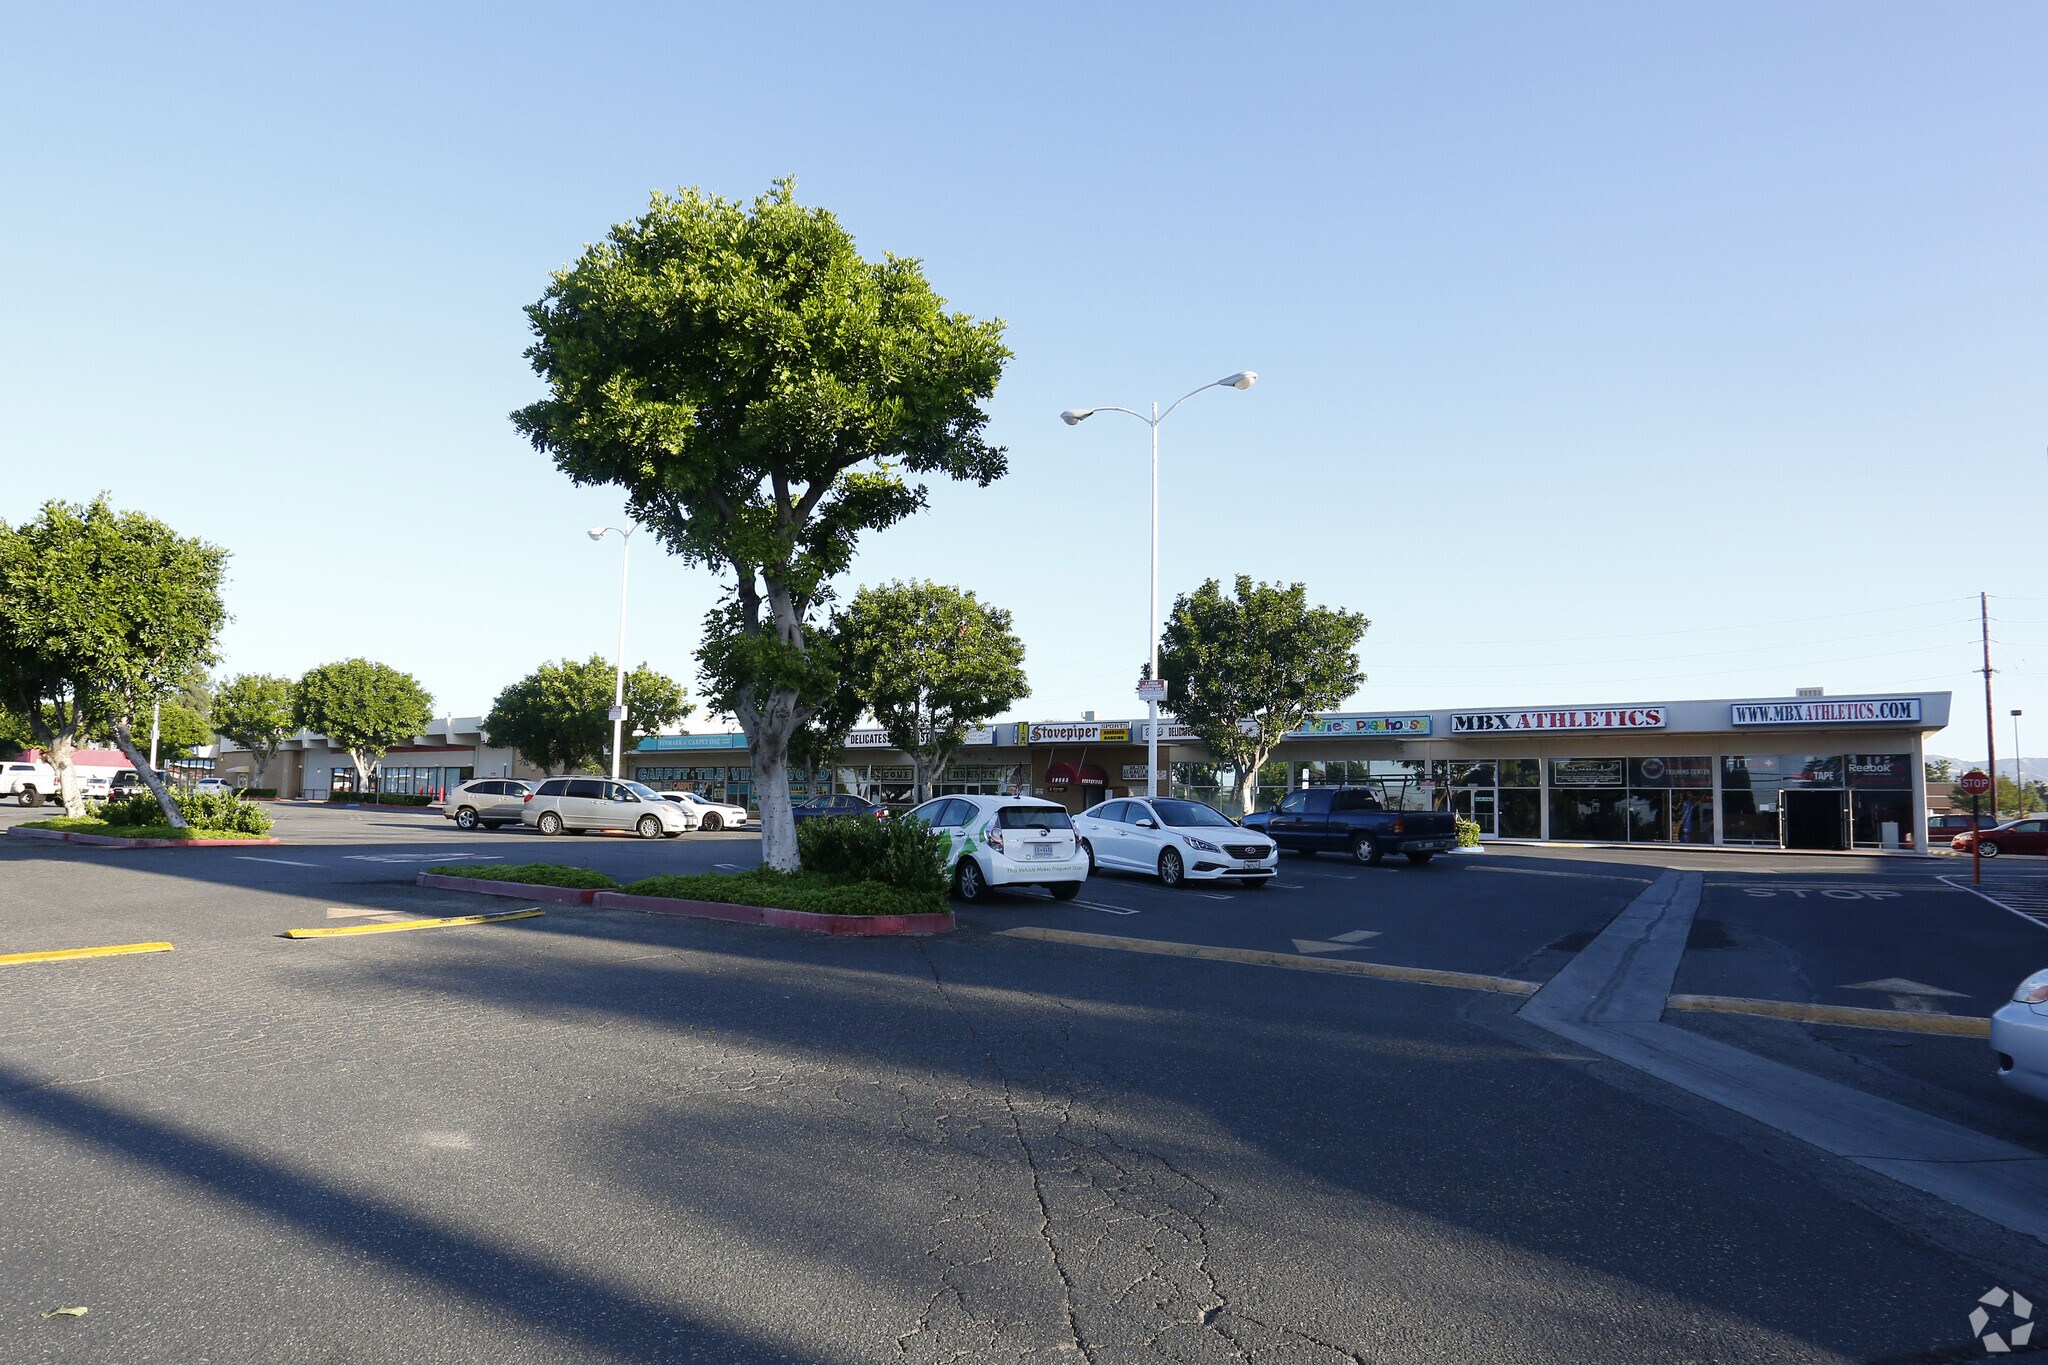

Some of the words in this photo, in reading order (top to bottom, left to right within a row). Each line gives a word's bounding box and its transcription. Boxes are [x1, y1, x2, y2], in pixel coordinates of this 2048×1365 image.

[1454, 714, 1511, 731] MBX
[1515, 709, 1661, 729] ATHLETICS
[1030, 724, 1099, 741] Stovepiper
[638, 767, 689, 780] CARPET
[695, 768, 725, 780] TILE
[1848, 763, 1893, 772] Reebok
[1962, 778, 1989, 788] STOP
[1743, 887, 1903, 901] STOP
